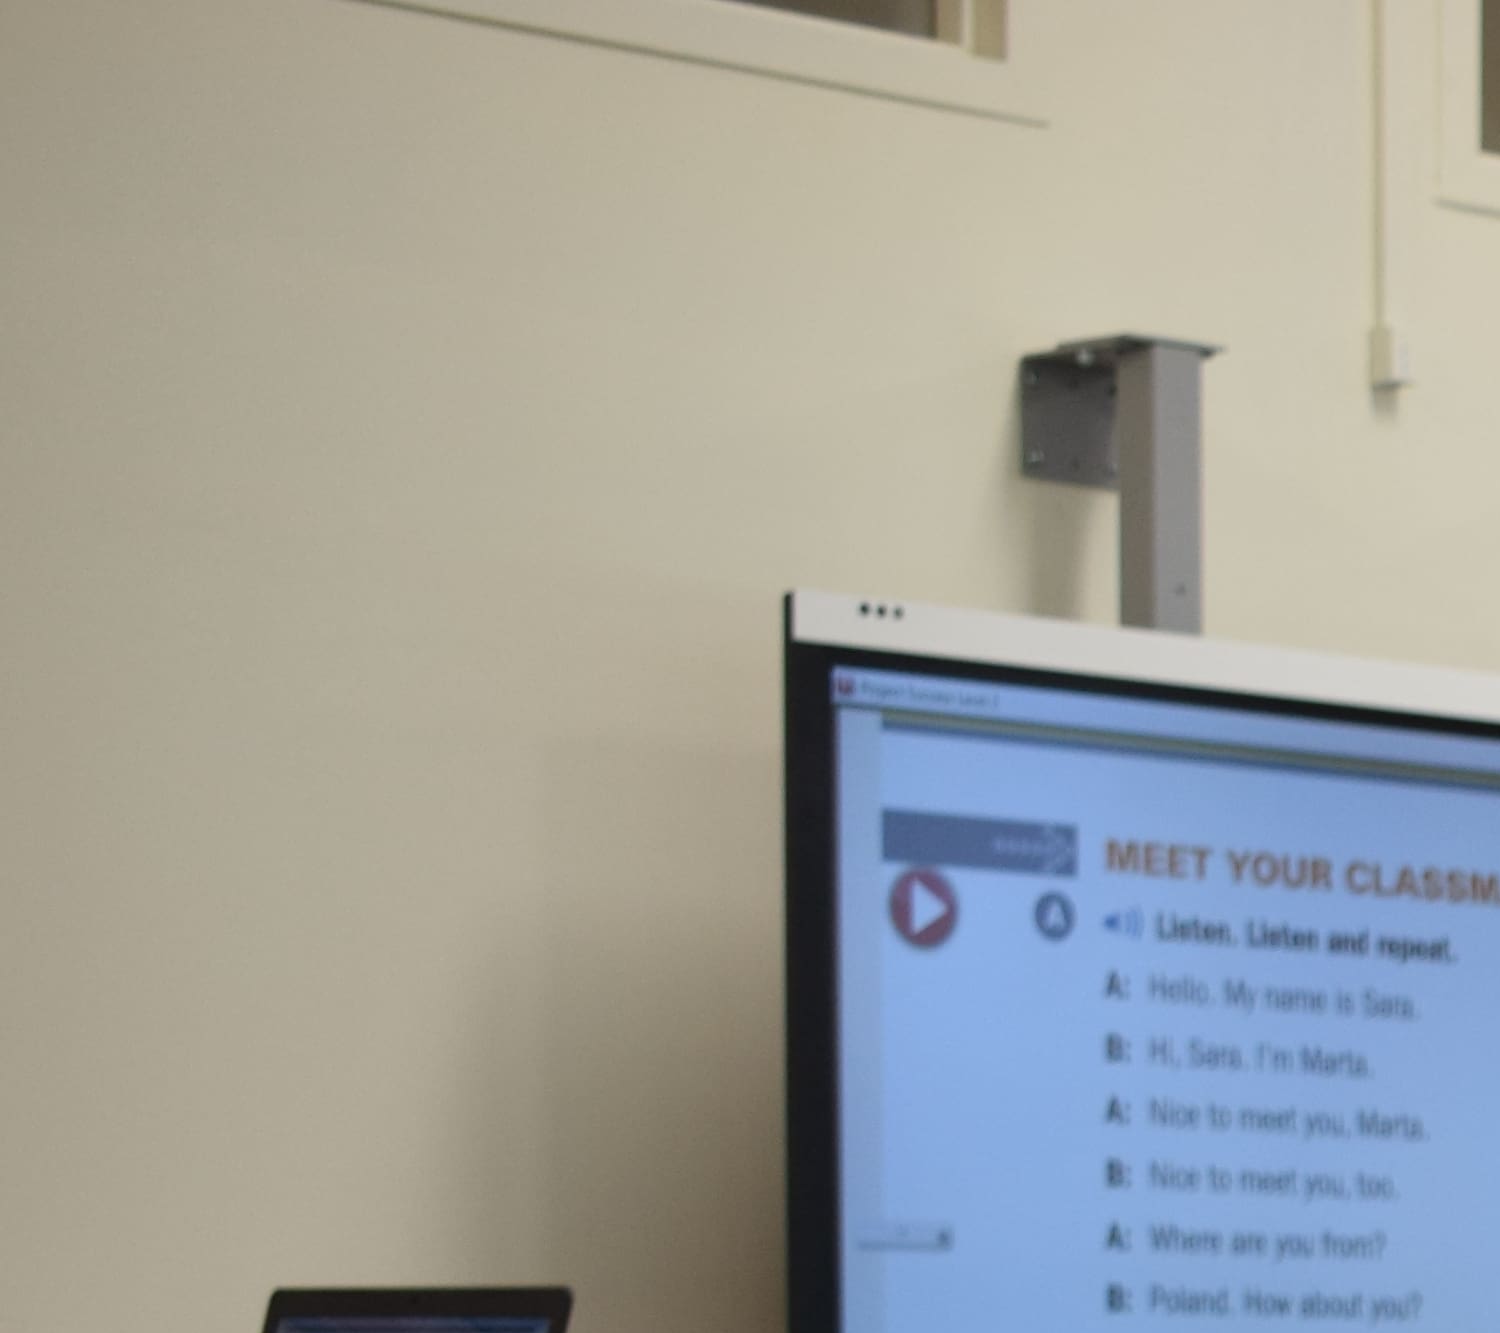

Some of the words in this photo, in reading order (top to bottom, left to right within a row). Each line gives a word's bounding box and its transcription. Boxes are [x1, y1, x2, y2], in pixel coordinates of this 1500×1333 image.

[1106, 840, 1213, 881] MEET
[1229, 850, 1333, 892] YOUR
[1157, 912, 1237, 947] Listen.
[1247, 920, 1319, 952] Listen
[1327, 929, 1370, 957] and
[1379, 935, 1457, 966] repeat.
[1106, 972, 1130, 1000] A:
[1149, 975, 1207, 1005] Hello.
[1222, 980, 1257, 1012] My
[1265, 986, 1328, 1013] name
[1337, 988, 1354, 1015] is
[1362, 990, 1419, 1021] Sara.
[1106, 1035, 1130, 1063] B:
[1187, 1039, 1249, 1072] Sara.
[1257, 1042, 1295, 1072] I'm
[1301, 1045, 1373, 1078] Marta.
[1106, 1097, 1130, 1125] A:
[1149, 1098, 1201, 1128] Nice
[1207, 1102, 1232, 1130] to
[1240, 1104, 1298, 1133] meet
[1305, 1110, 1353, 1143] you,
[1359, 1109, 1429, 1141] Marta.
[1106, 1160, 1130, 1188] B:
[1149, 1162, 1201, 1191] Nice
[1207, 1165, 1232, 1192] to
[1240, 1167, 1298, 1195] meet
[1305, 1171, 1352, 1203] you,
[1106, 1224, 1130, 1252] A:
[1149, 1224, 1221, 1254] Where
[1232, 1232, 1269, 1256] are
[1275, 1233, 1315, 1263] you
[1321, 1230, 1387, 1260] from?
[1106, 1286, 1130, 1314] B:
[1149, 1286, 1231, 1316] Poland.
[1243, 1288, 1292, 1317] How
[1300, 1290, 1363, 1319] about
[1371, 1292, 1423, 1324] you?
